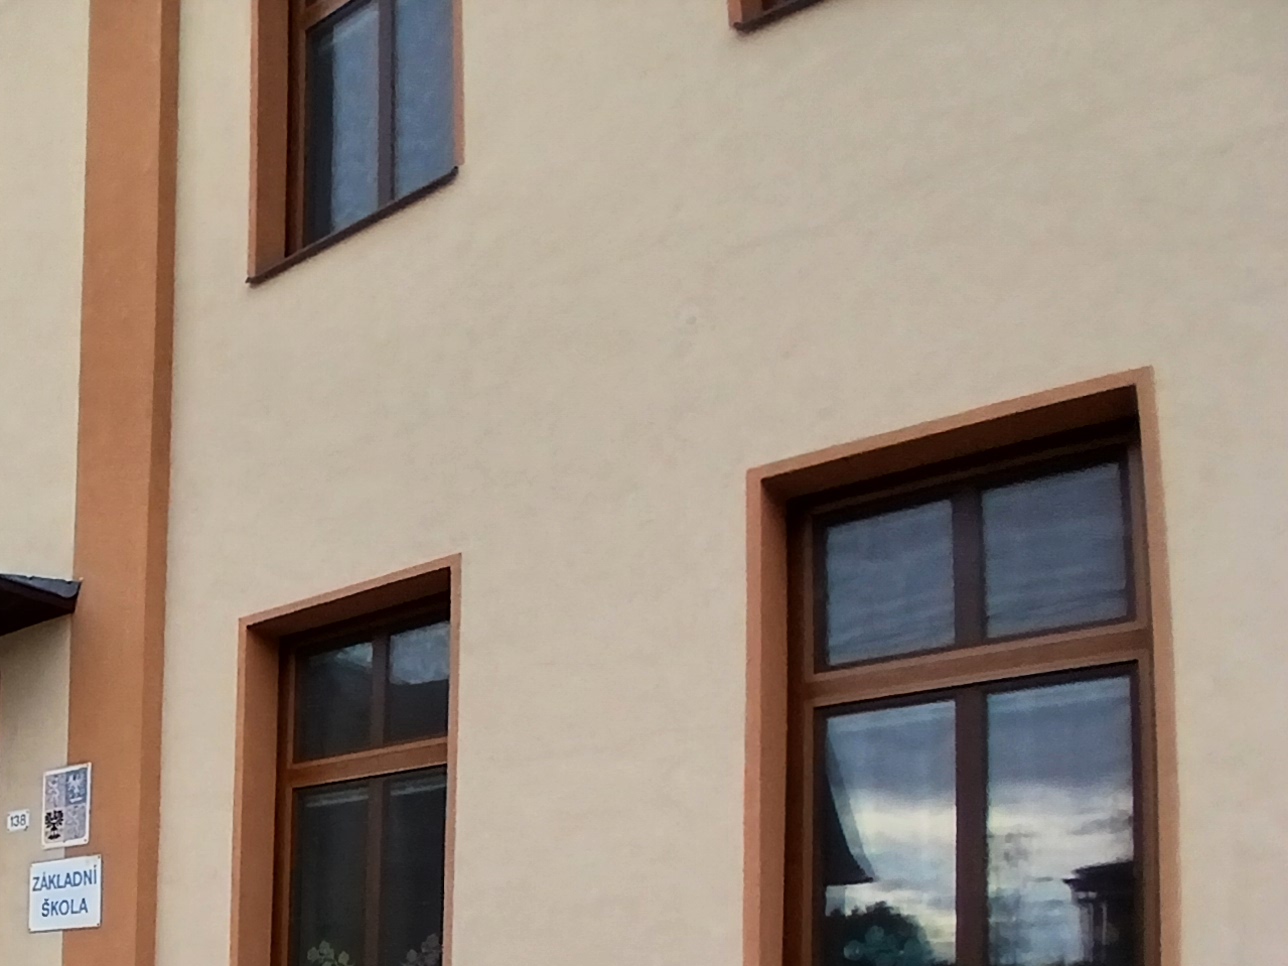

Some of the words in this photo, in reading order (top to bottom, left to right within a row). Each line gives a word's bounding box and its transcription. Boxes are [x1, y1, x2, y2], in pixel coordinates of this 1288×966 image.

[10, 814, 26, 827] 138
[32, 864, 97, 892] ZÁKLADNÍ
[41, 898, 88, 917] ŠKOLA
